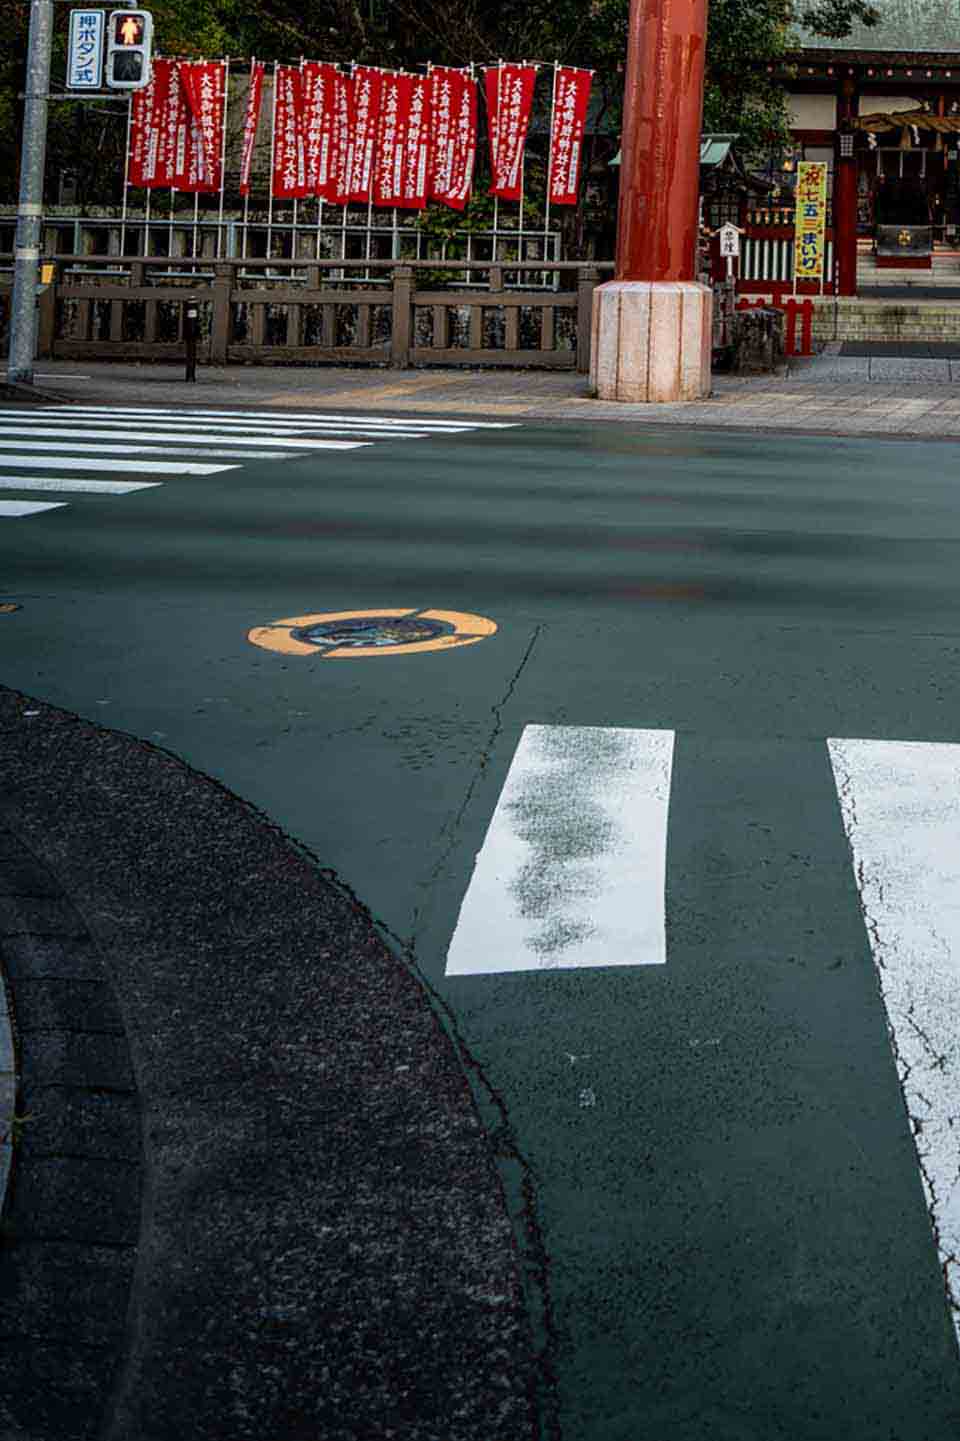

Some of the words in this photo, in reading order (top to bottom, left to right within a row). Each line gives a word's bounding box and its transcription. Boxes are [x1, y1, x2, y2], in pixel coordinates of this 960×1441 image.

[75, 15, 97, 82] 押ボタン式
[803, 164, 820, 269] 祝七五三まいり
